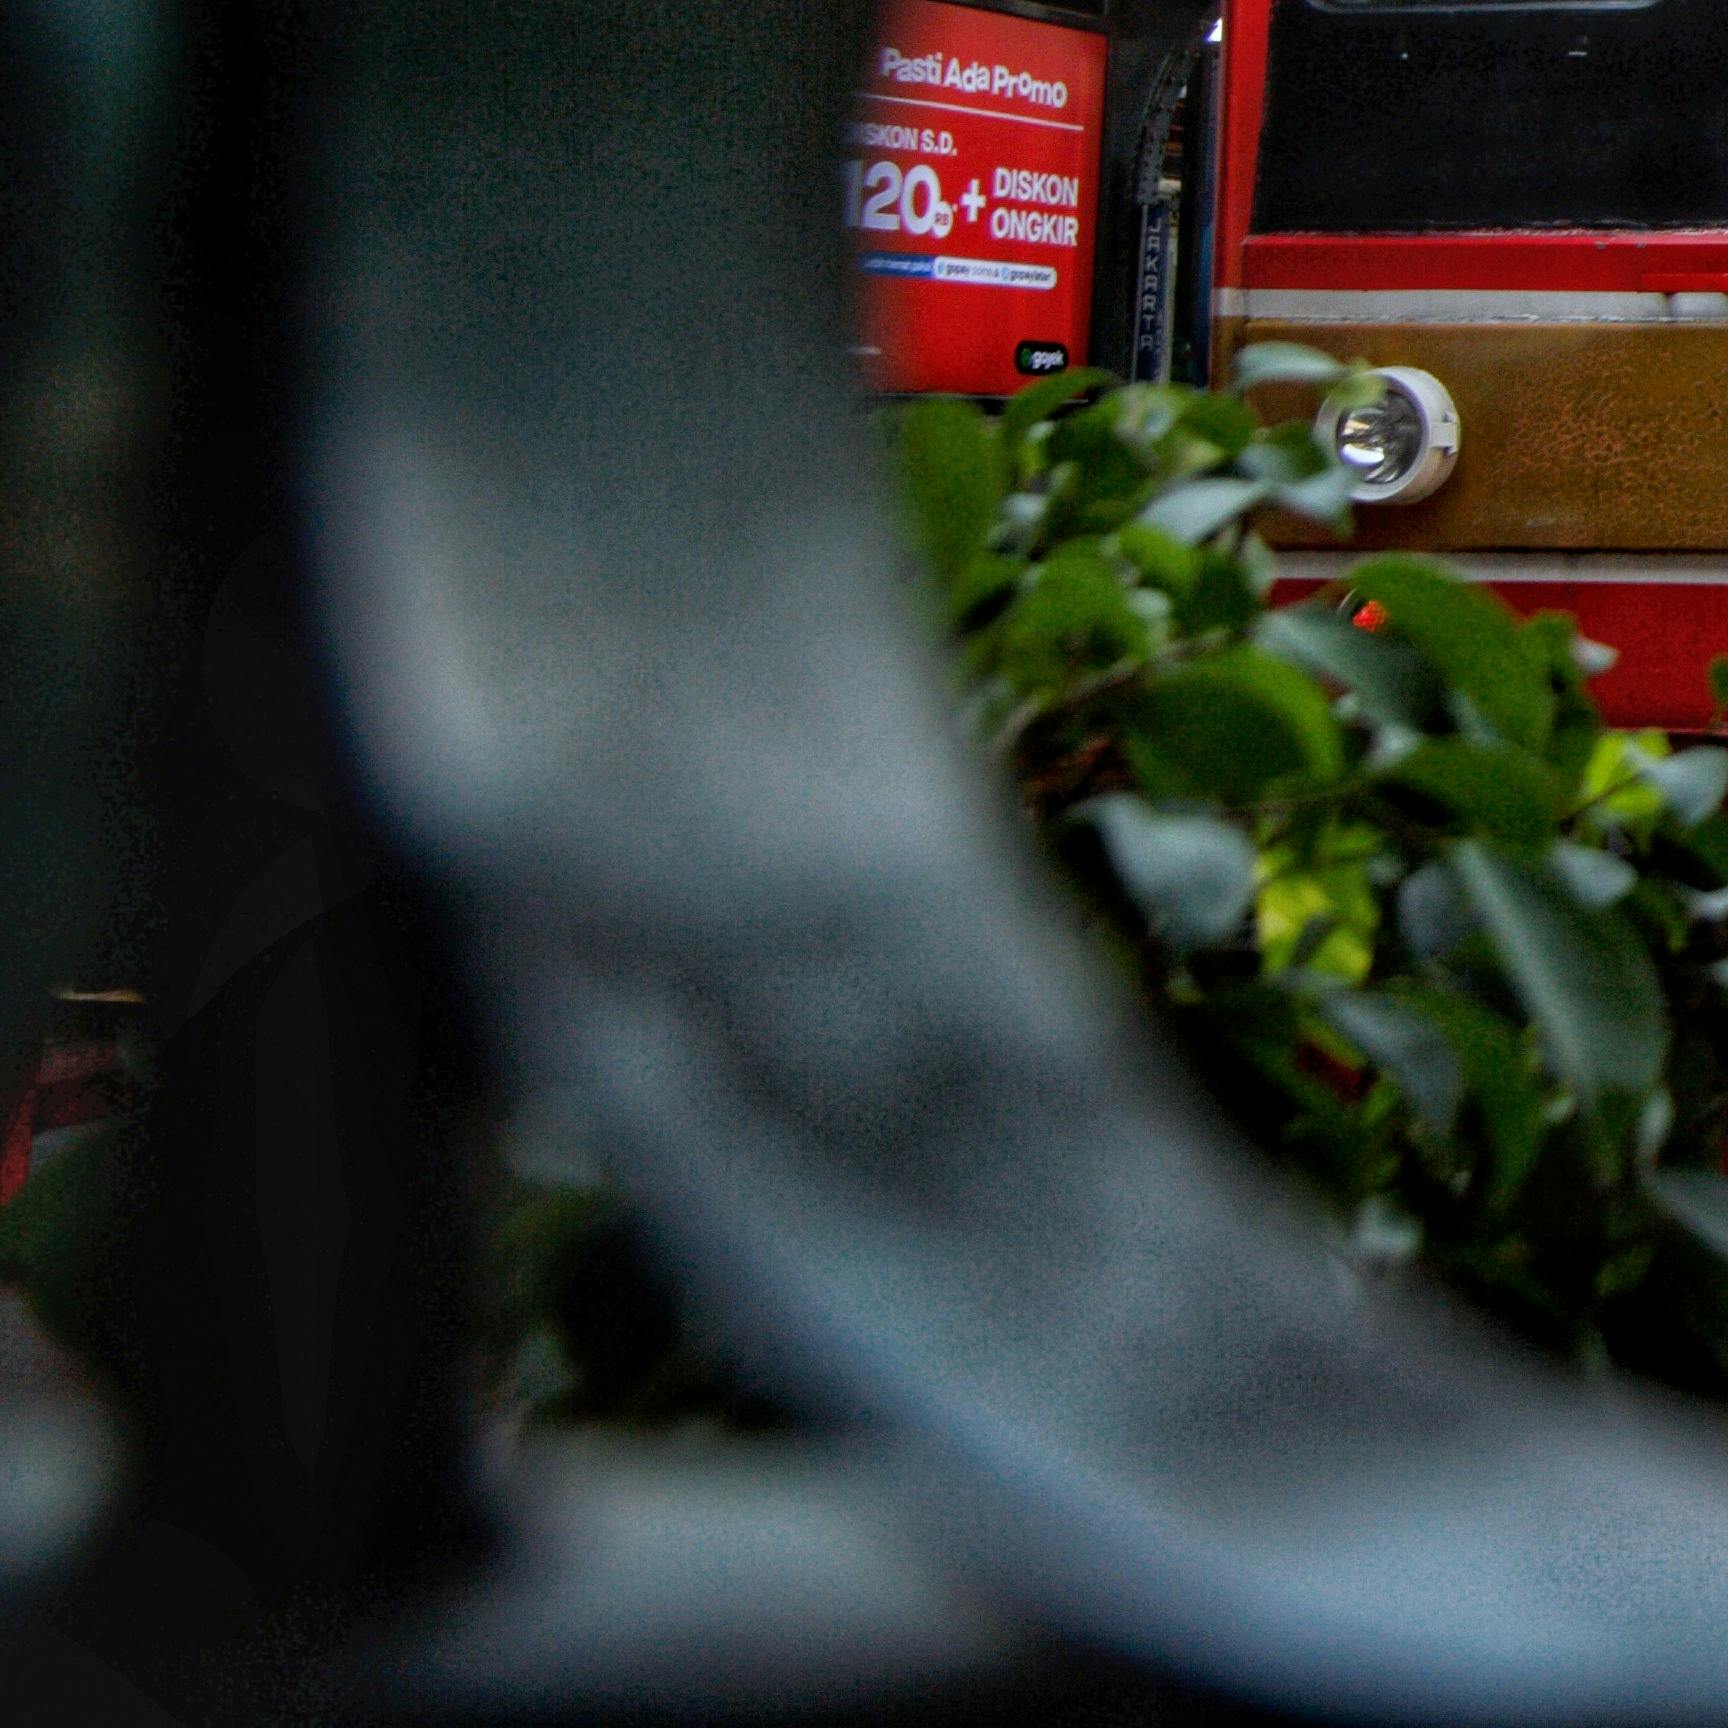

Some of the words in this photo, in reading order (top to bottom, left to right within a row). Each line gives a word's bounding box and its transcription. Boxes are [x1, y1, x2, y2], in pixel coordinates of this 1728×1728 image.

[881, 46, 943, 86] Pasti
[944, 57, 990, 93] Ada
[991, 64, 1068, 108] Promo
[920, 128, 957, 156] S.D.
[992, 167, 1079, 207] DISKON
[990, 207, 1080, 247] ONGKIR
